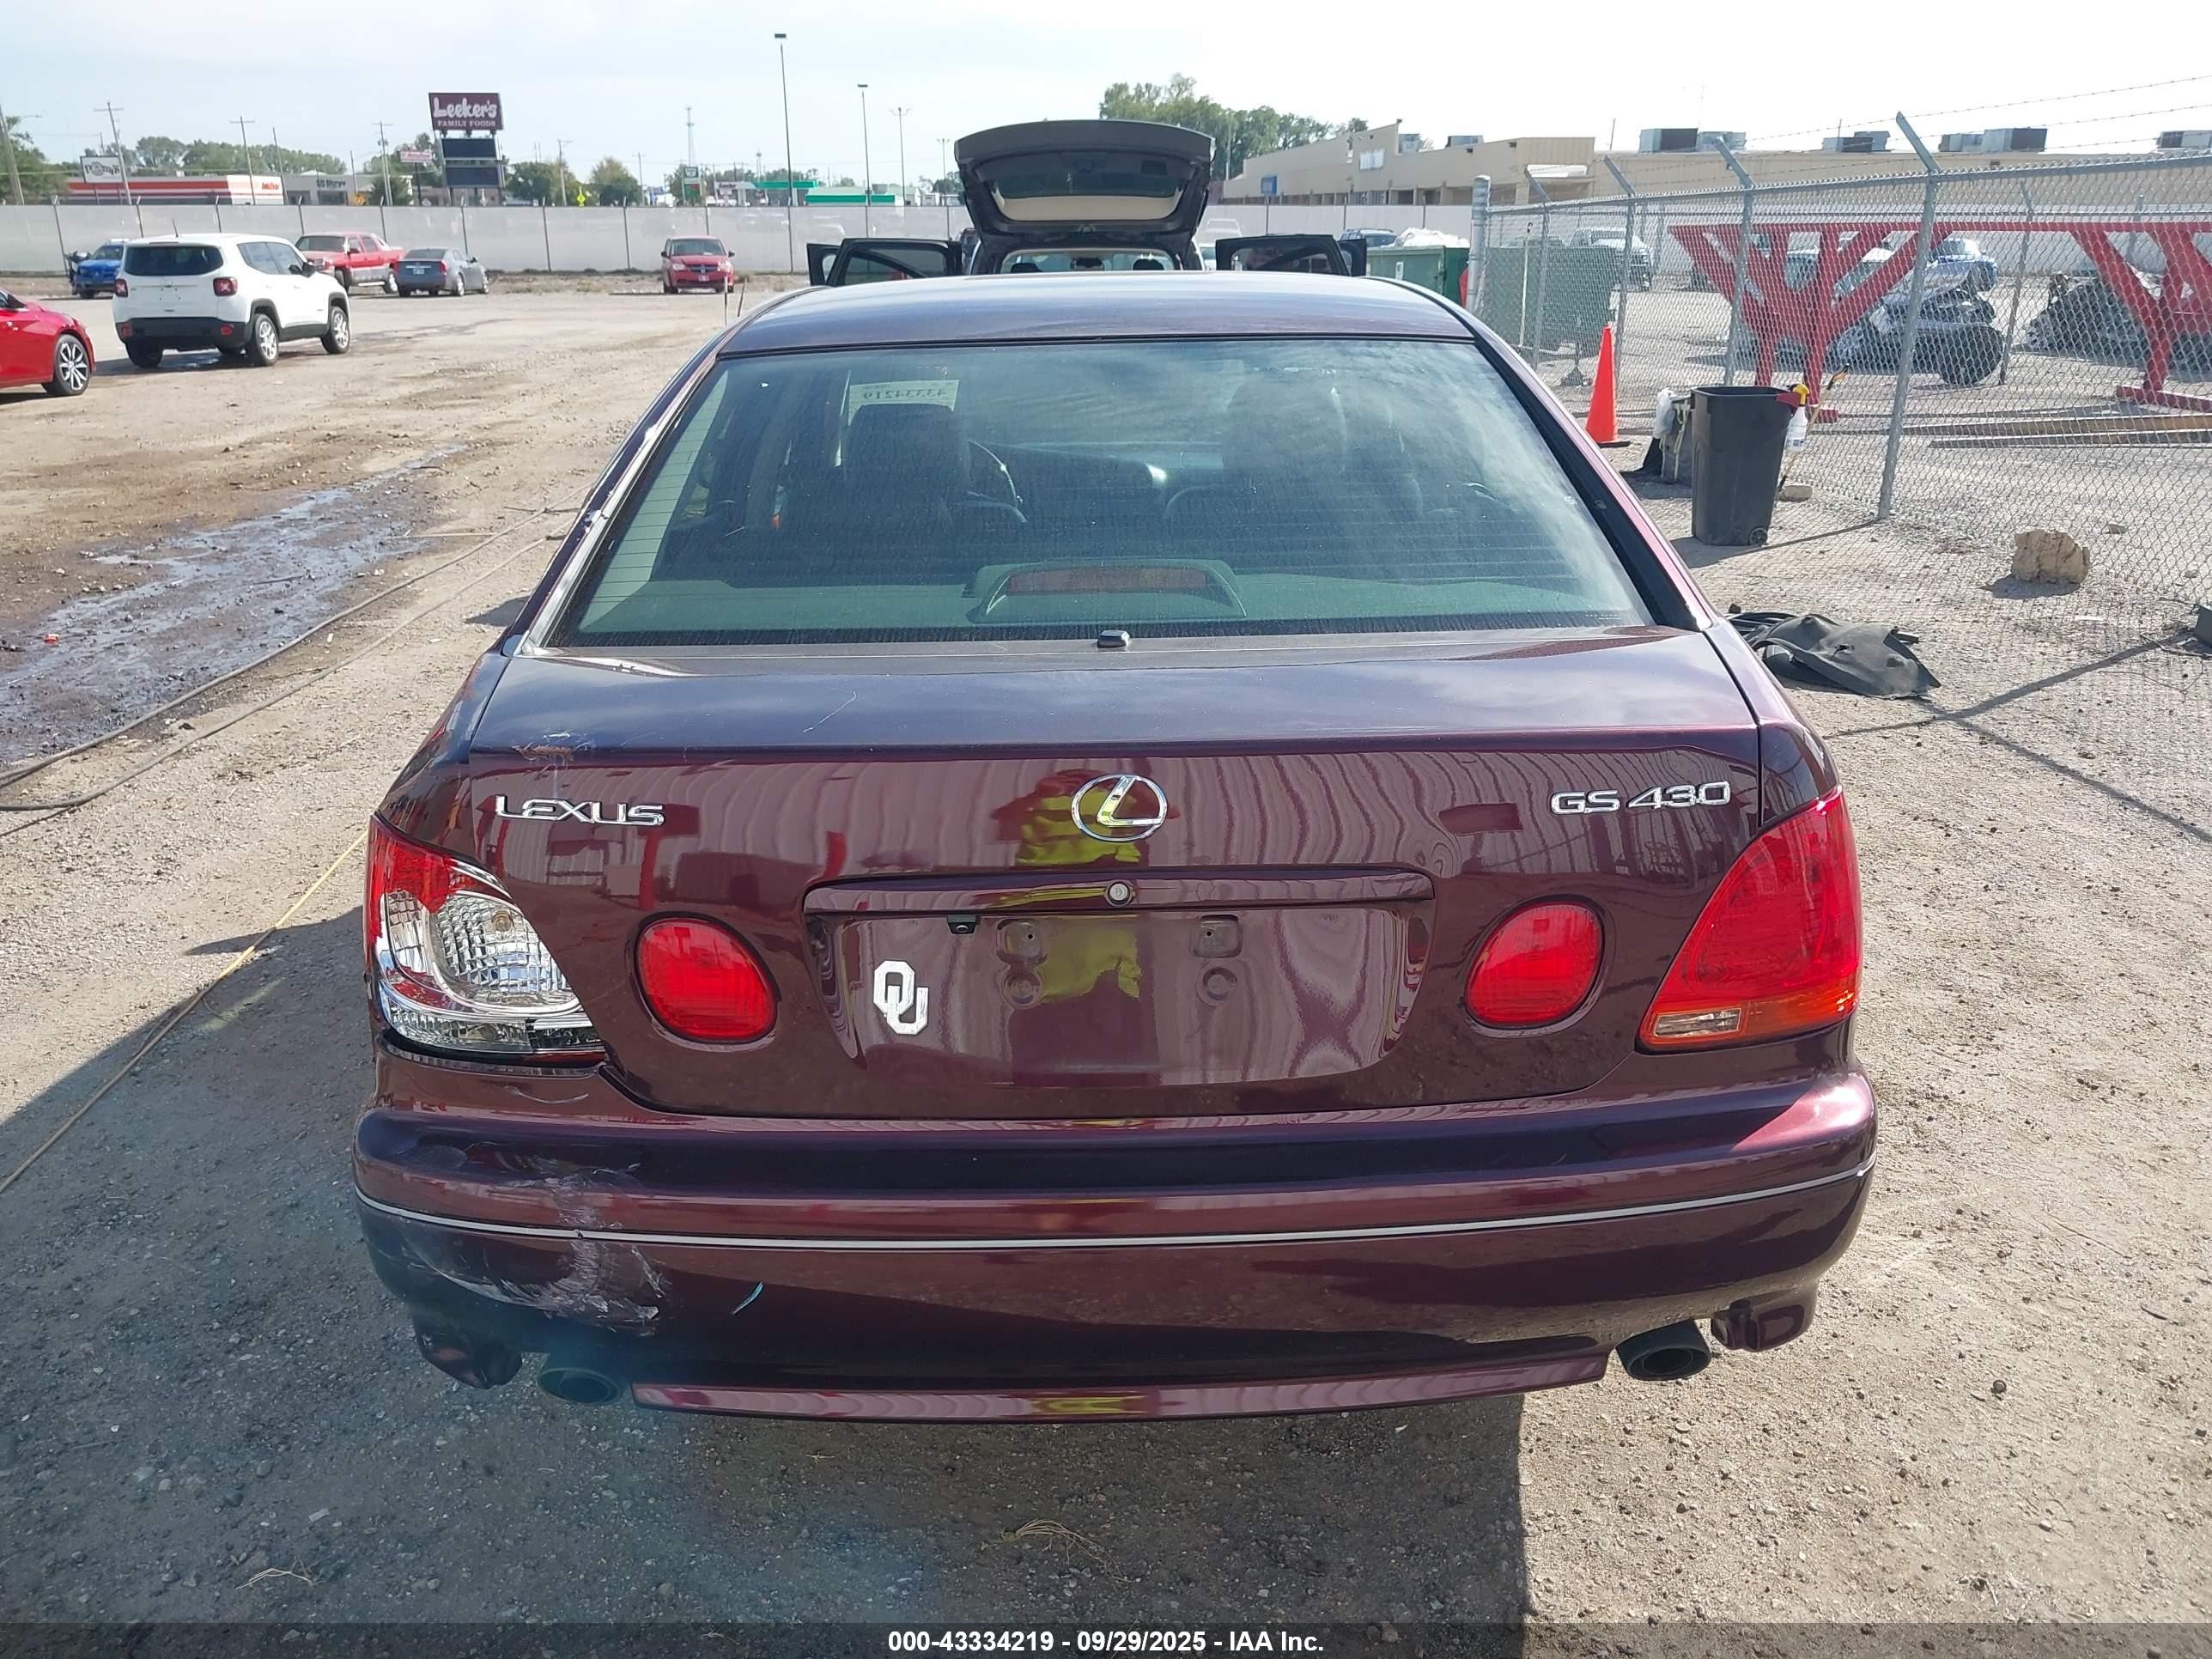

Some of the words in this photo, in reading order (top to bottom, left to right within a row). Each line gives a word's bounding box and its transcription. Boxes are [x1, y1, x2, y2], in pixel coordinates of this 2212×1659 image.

[433, 97, 497, 118] Leeker's
[495, 795, 665, 825] LEXUS
[1552, 789, 1620, 814] GS
[1628, 780, 1731, 809] 430
[873, 960, 929, 1036] OU
